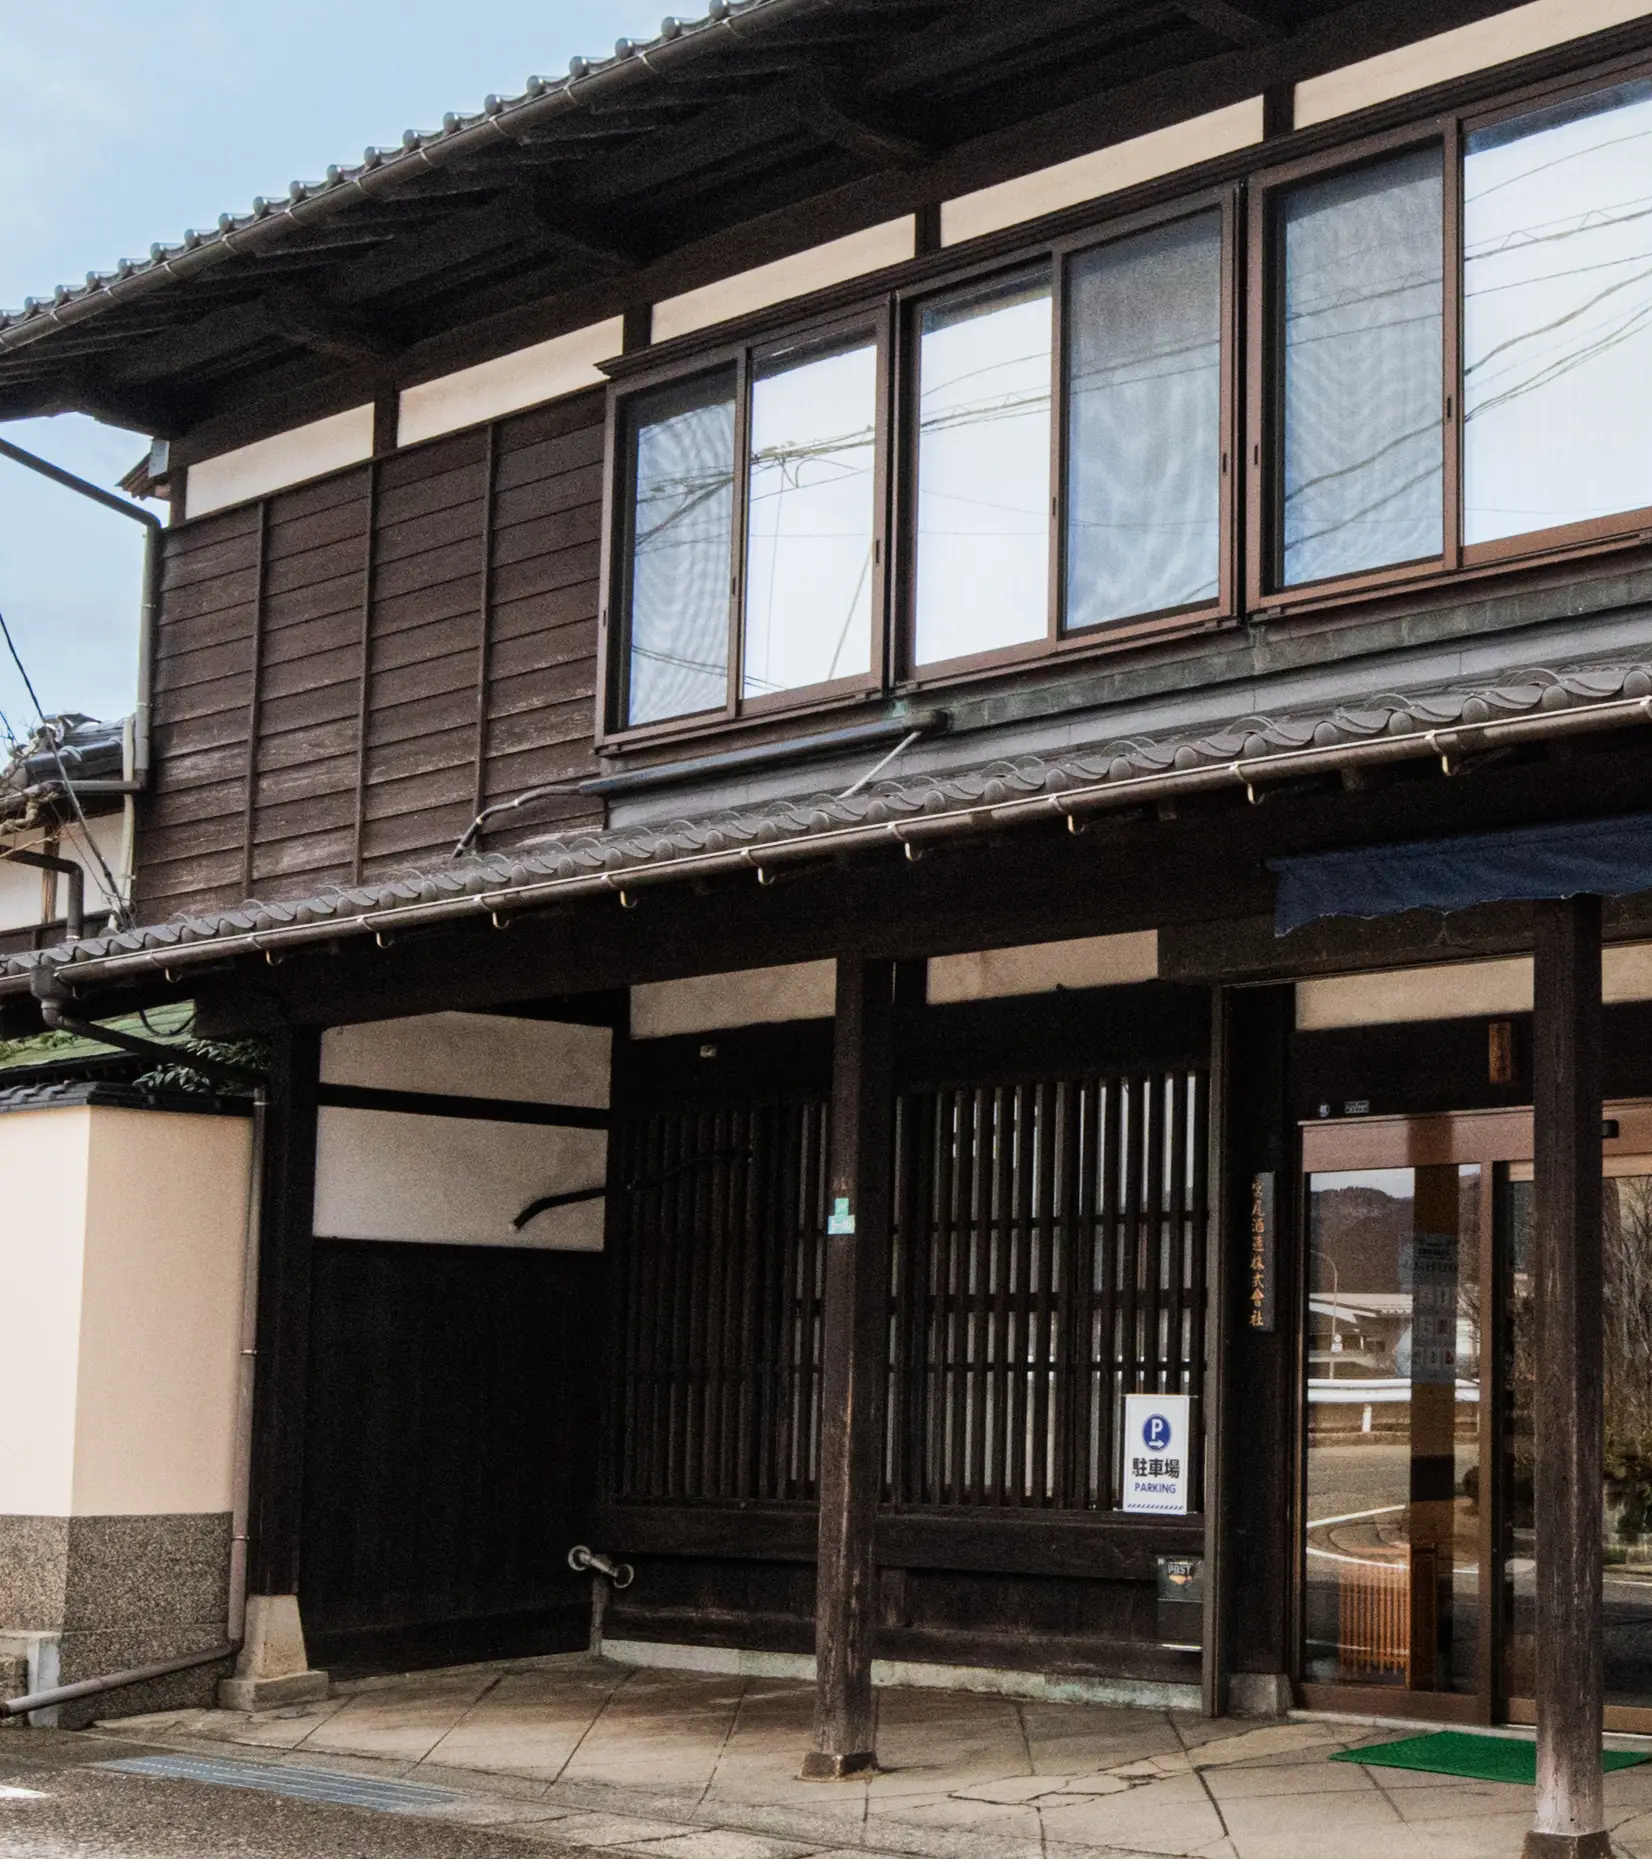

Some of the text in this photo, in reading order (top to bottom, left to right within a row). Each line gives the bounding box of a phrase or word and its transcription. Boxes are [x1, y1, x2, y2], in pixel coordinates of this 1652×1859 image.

[1151, 1418, 1164, 1440] P
[1132, 1457, 1181, 1479] 駐車場
[1134, 1482, 1176, 1494] PARKING
